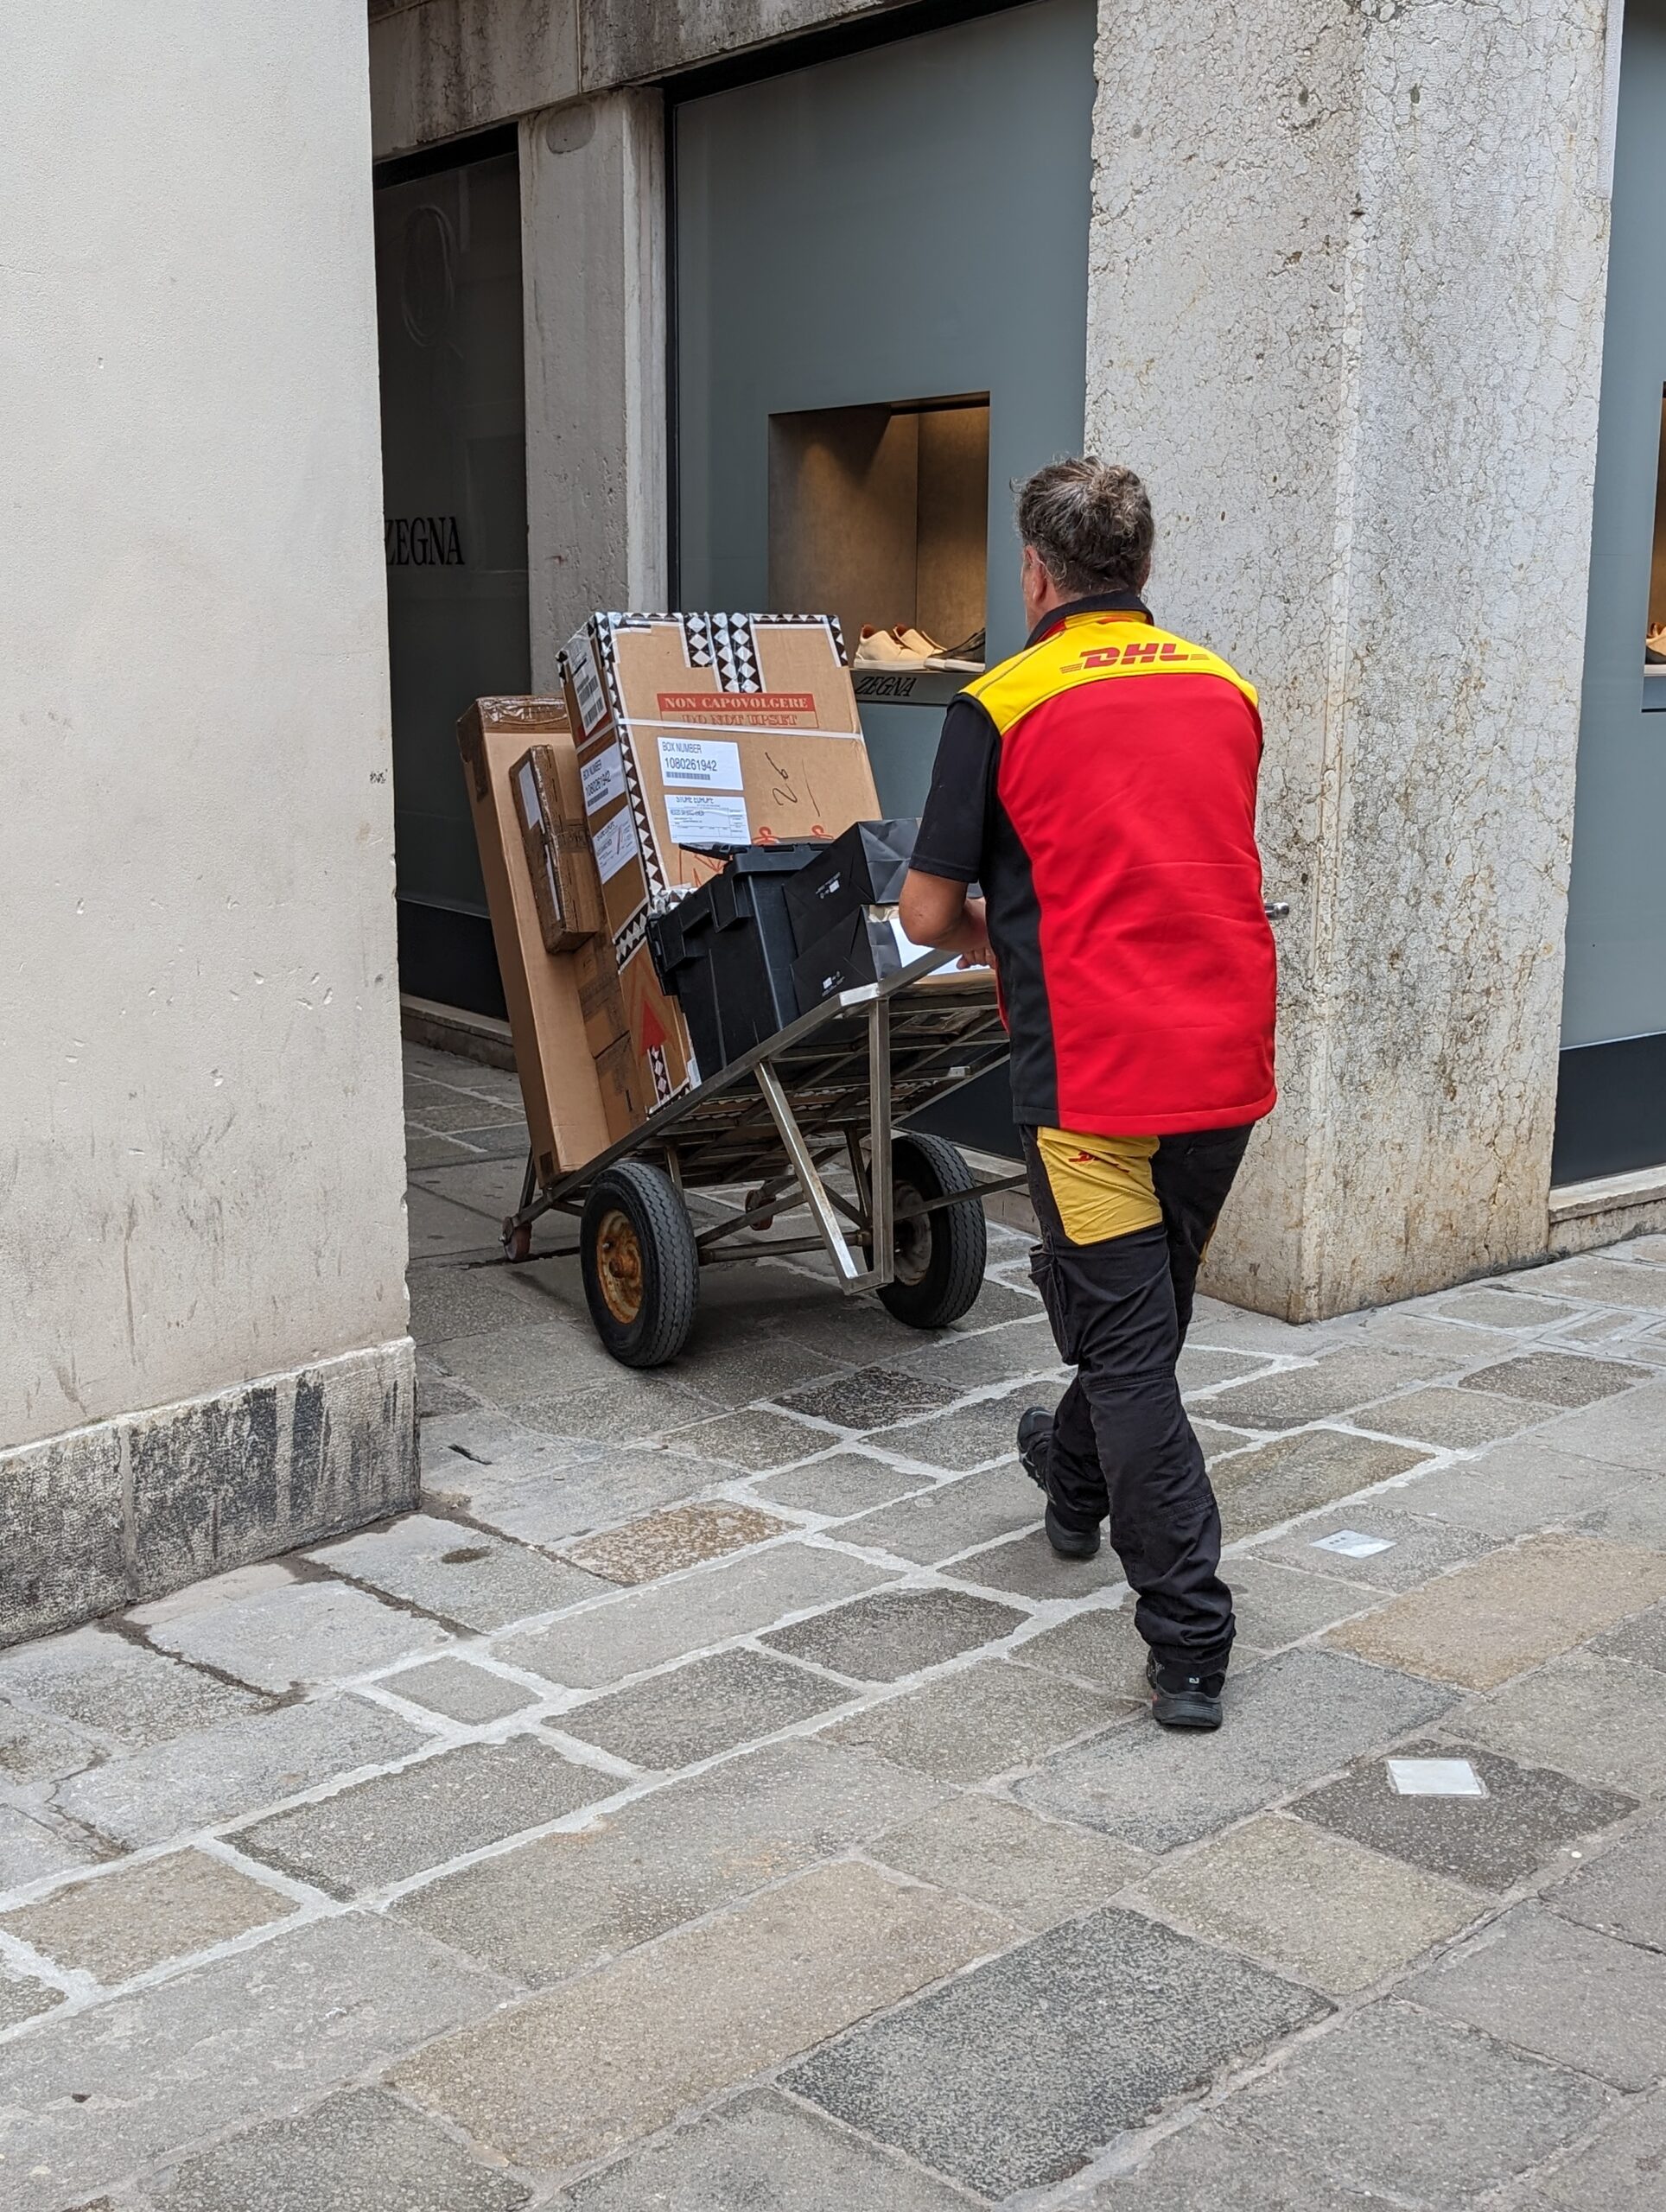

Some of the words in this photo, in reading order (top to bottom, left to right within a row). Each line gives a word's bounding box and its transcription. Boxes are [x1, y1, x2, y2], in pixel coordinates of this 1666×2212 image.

[1079, 643, 1189, 670] DHL
[855, 675, 918, 697] ZEGNA
[664, 697, 696, 709] NON
[702, 697, 809, 709] CAPOVOLGERE
[682, 714, 707, 725] DO
[709, 715, 744, 726] NOT
[747, 714, 798, 726] UPSET
[662, 741, 676, 752] BOX
[676, 743, 703, 753] NUMBER
[664, 757, 718, 772] 1080261942
